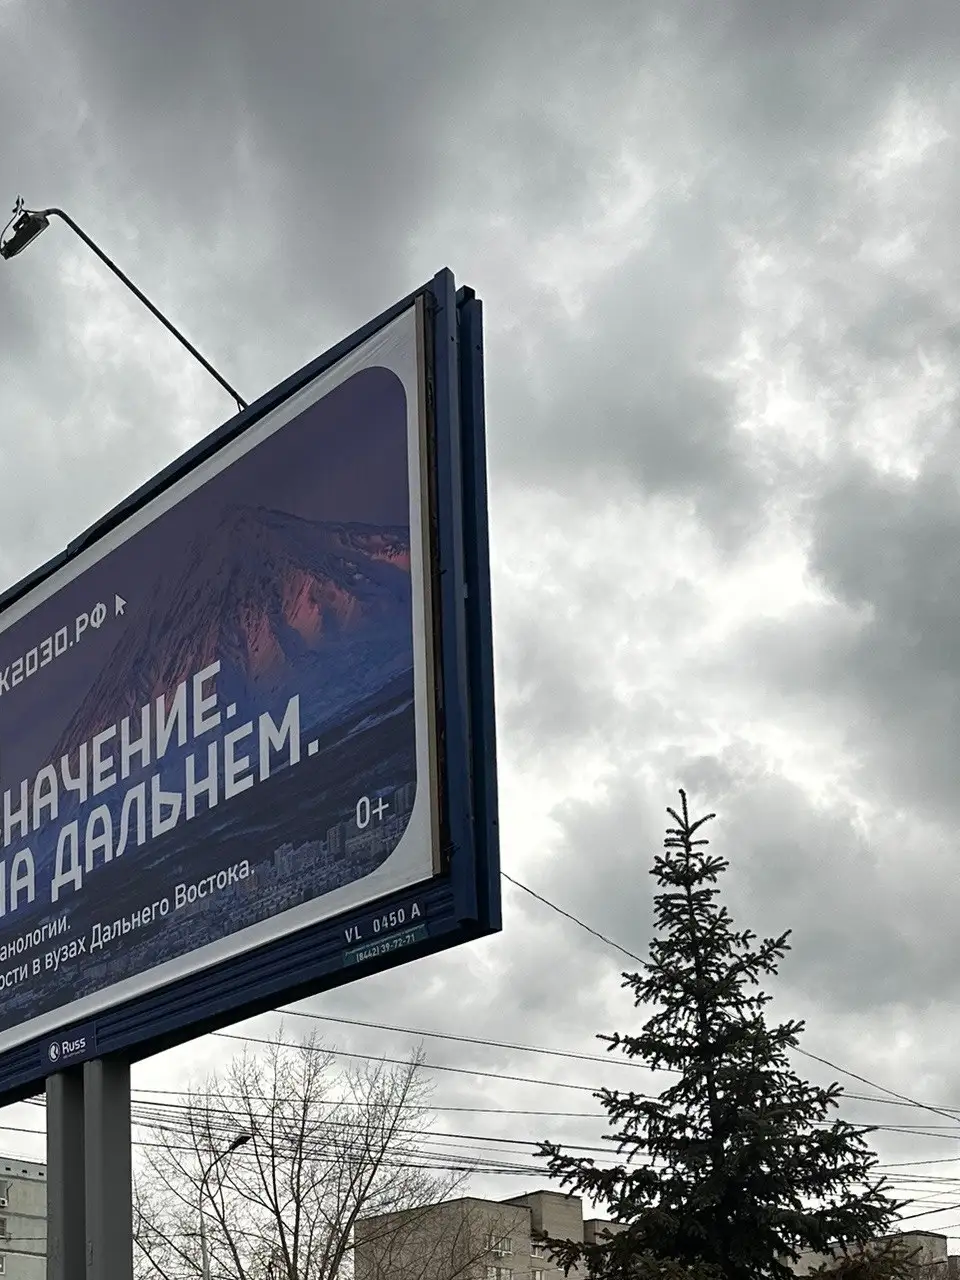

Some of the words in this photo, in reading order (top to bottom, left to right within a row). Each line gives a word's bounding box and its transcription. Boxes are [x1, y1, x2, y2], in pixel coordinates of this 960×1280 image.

[51, 694, 320, 902] ДАЛЬНЕМ.
[355, 795, 390, 829] 0+
[32, 960, 41, 976] в
[43, 937, 87, 971] вузах
[89, 898, 170, 959] Дальнего
[174, 859, 256, 909] Востока.
[344, 925, 362, 944] VL
[372, 908, 406, 933] 0450
[411, 902, 421, 919] A
[356, 946, 380, 963] (8442)
[380, 933, 415, 953] 39-72-71
[61, 1037, 86, 1055] Russ
